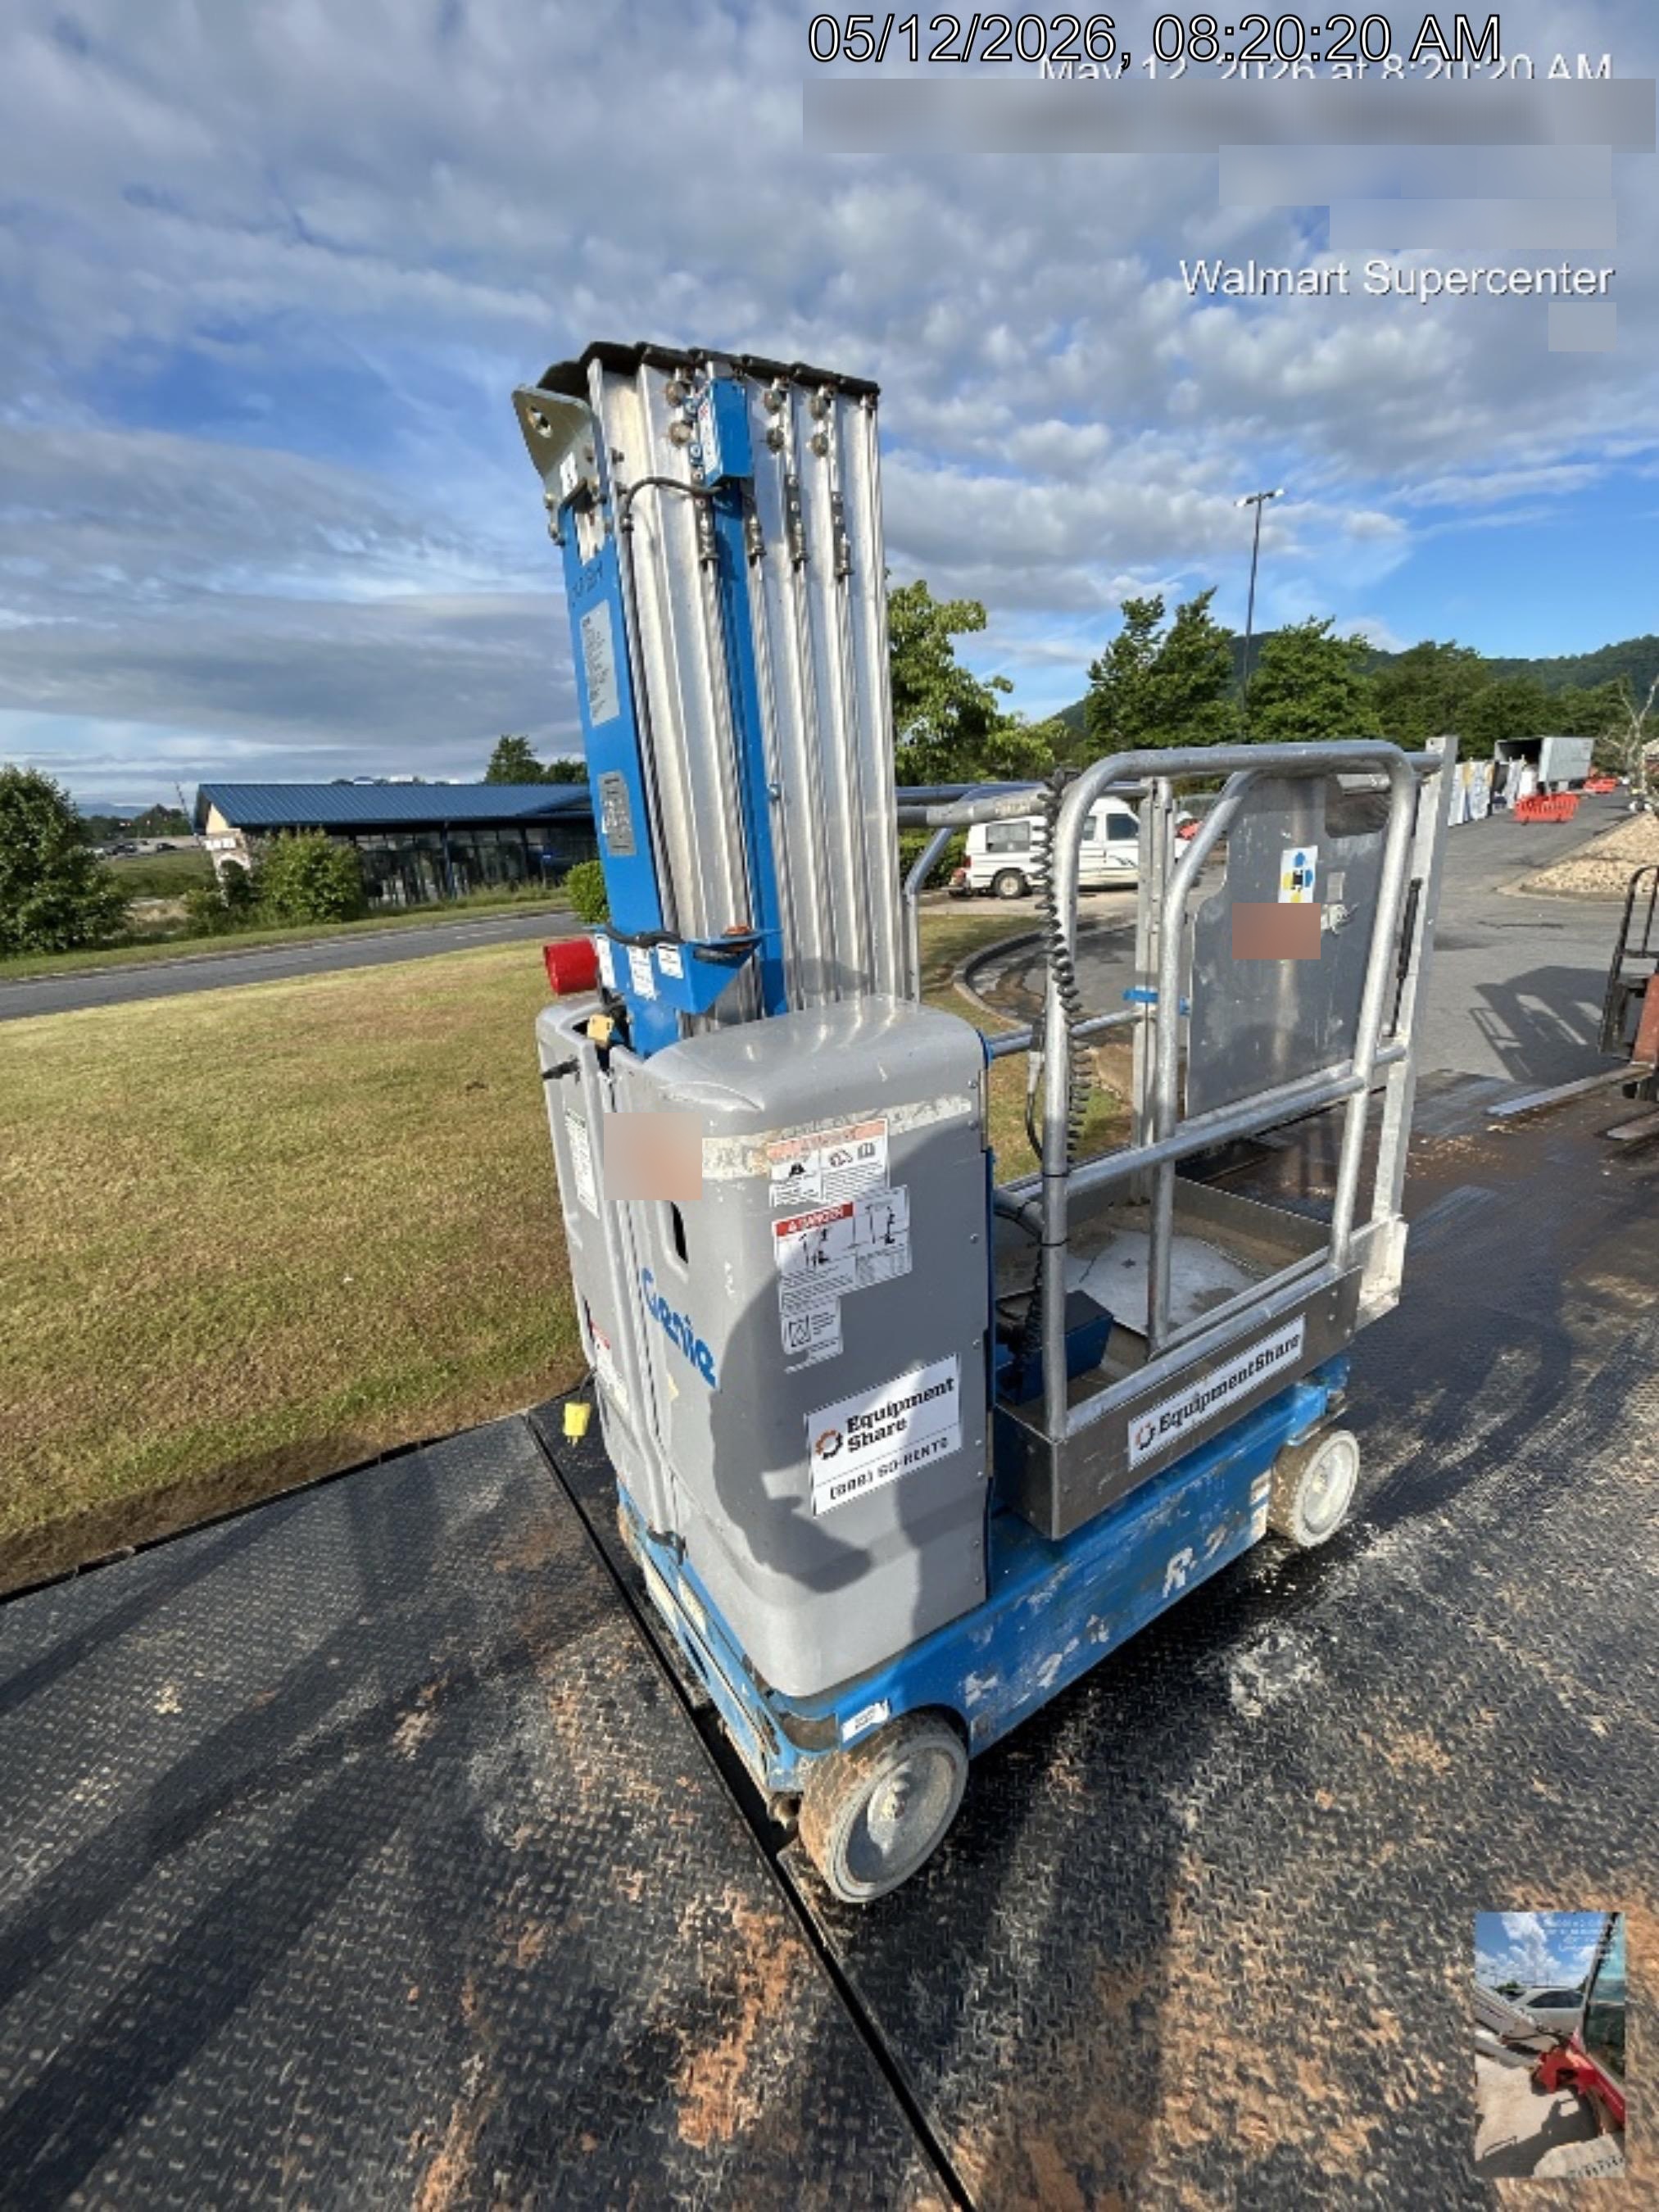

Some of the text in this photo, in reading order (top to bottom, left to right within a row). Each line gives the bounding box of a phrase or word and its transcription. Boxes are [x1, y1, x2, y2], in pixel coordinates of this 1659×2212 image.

[641, 1267, 717, 1389] Genie
[845, 1376, 954, 1434] Equipment
[1158, 1334, 1301, 1435] EquipmentShare
[847, 1417, 909, 1453] Share
